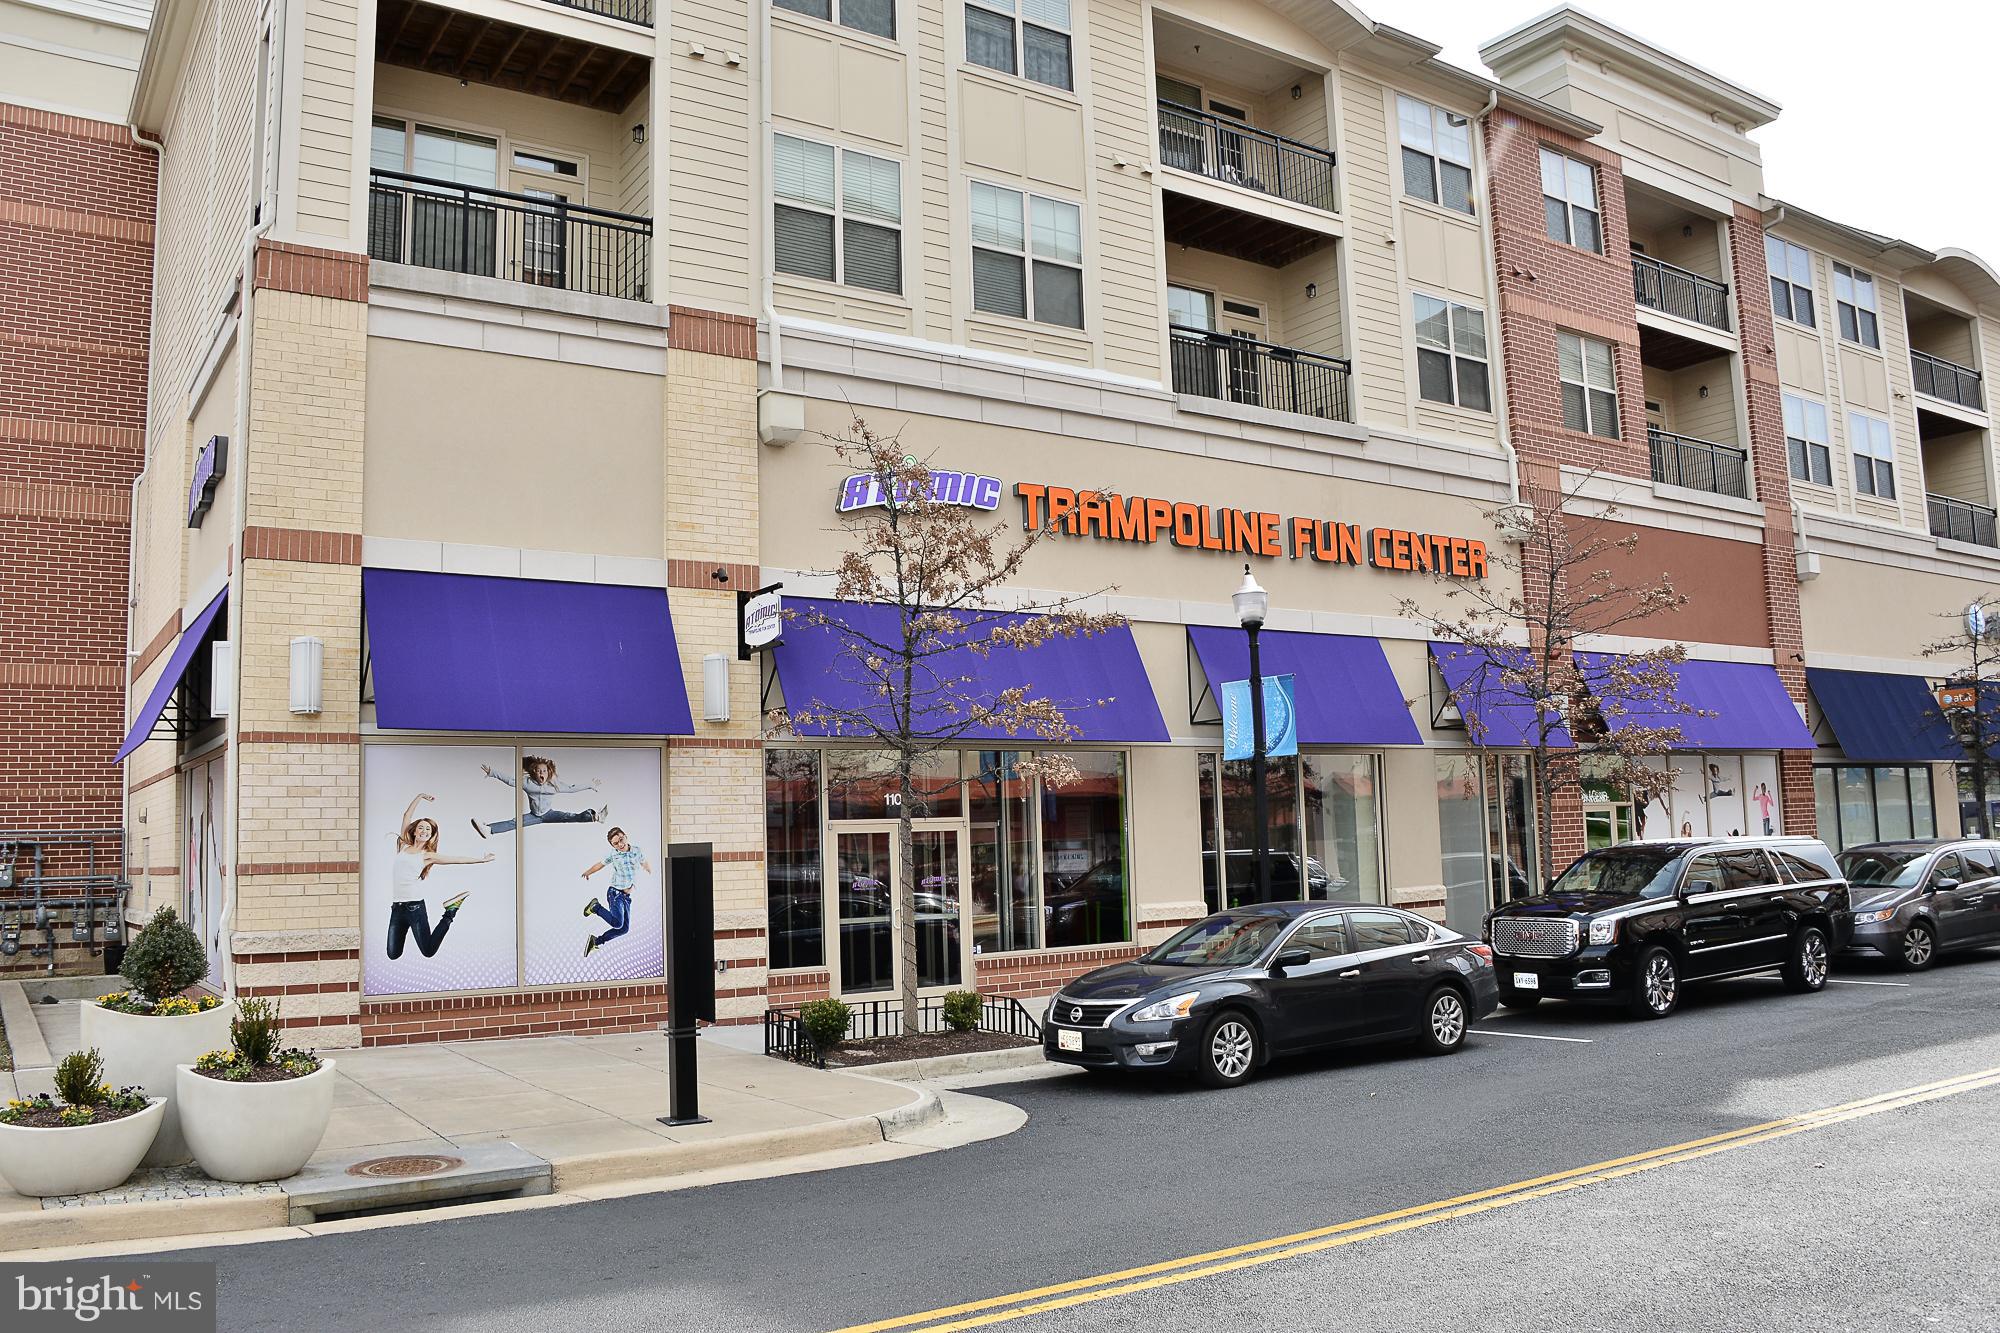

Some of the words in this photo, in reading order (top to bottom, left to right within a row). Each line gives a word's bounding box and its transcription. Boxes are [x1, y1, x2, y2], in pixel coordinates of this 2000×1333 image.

[1014, 482, 1283, 557] TRAMPOLINE
[1290, 516, 1363, 565] FUN
[1371, 527, 1489, 578] CENTER
[746, 604, 776, 630] ATOMIC
[1227, 692, 1241, 750] Welcome
